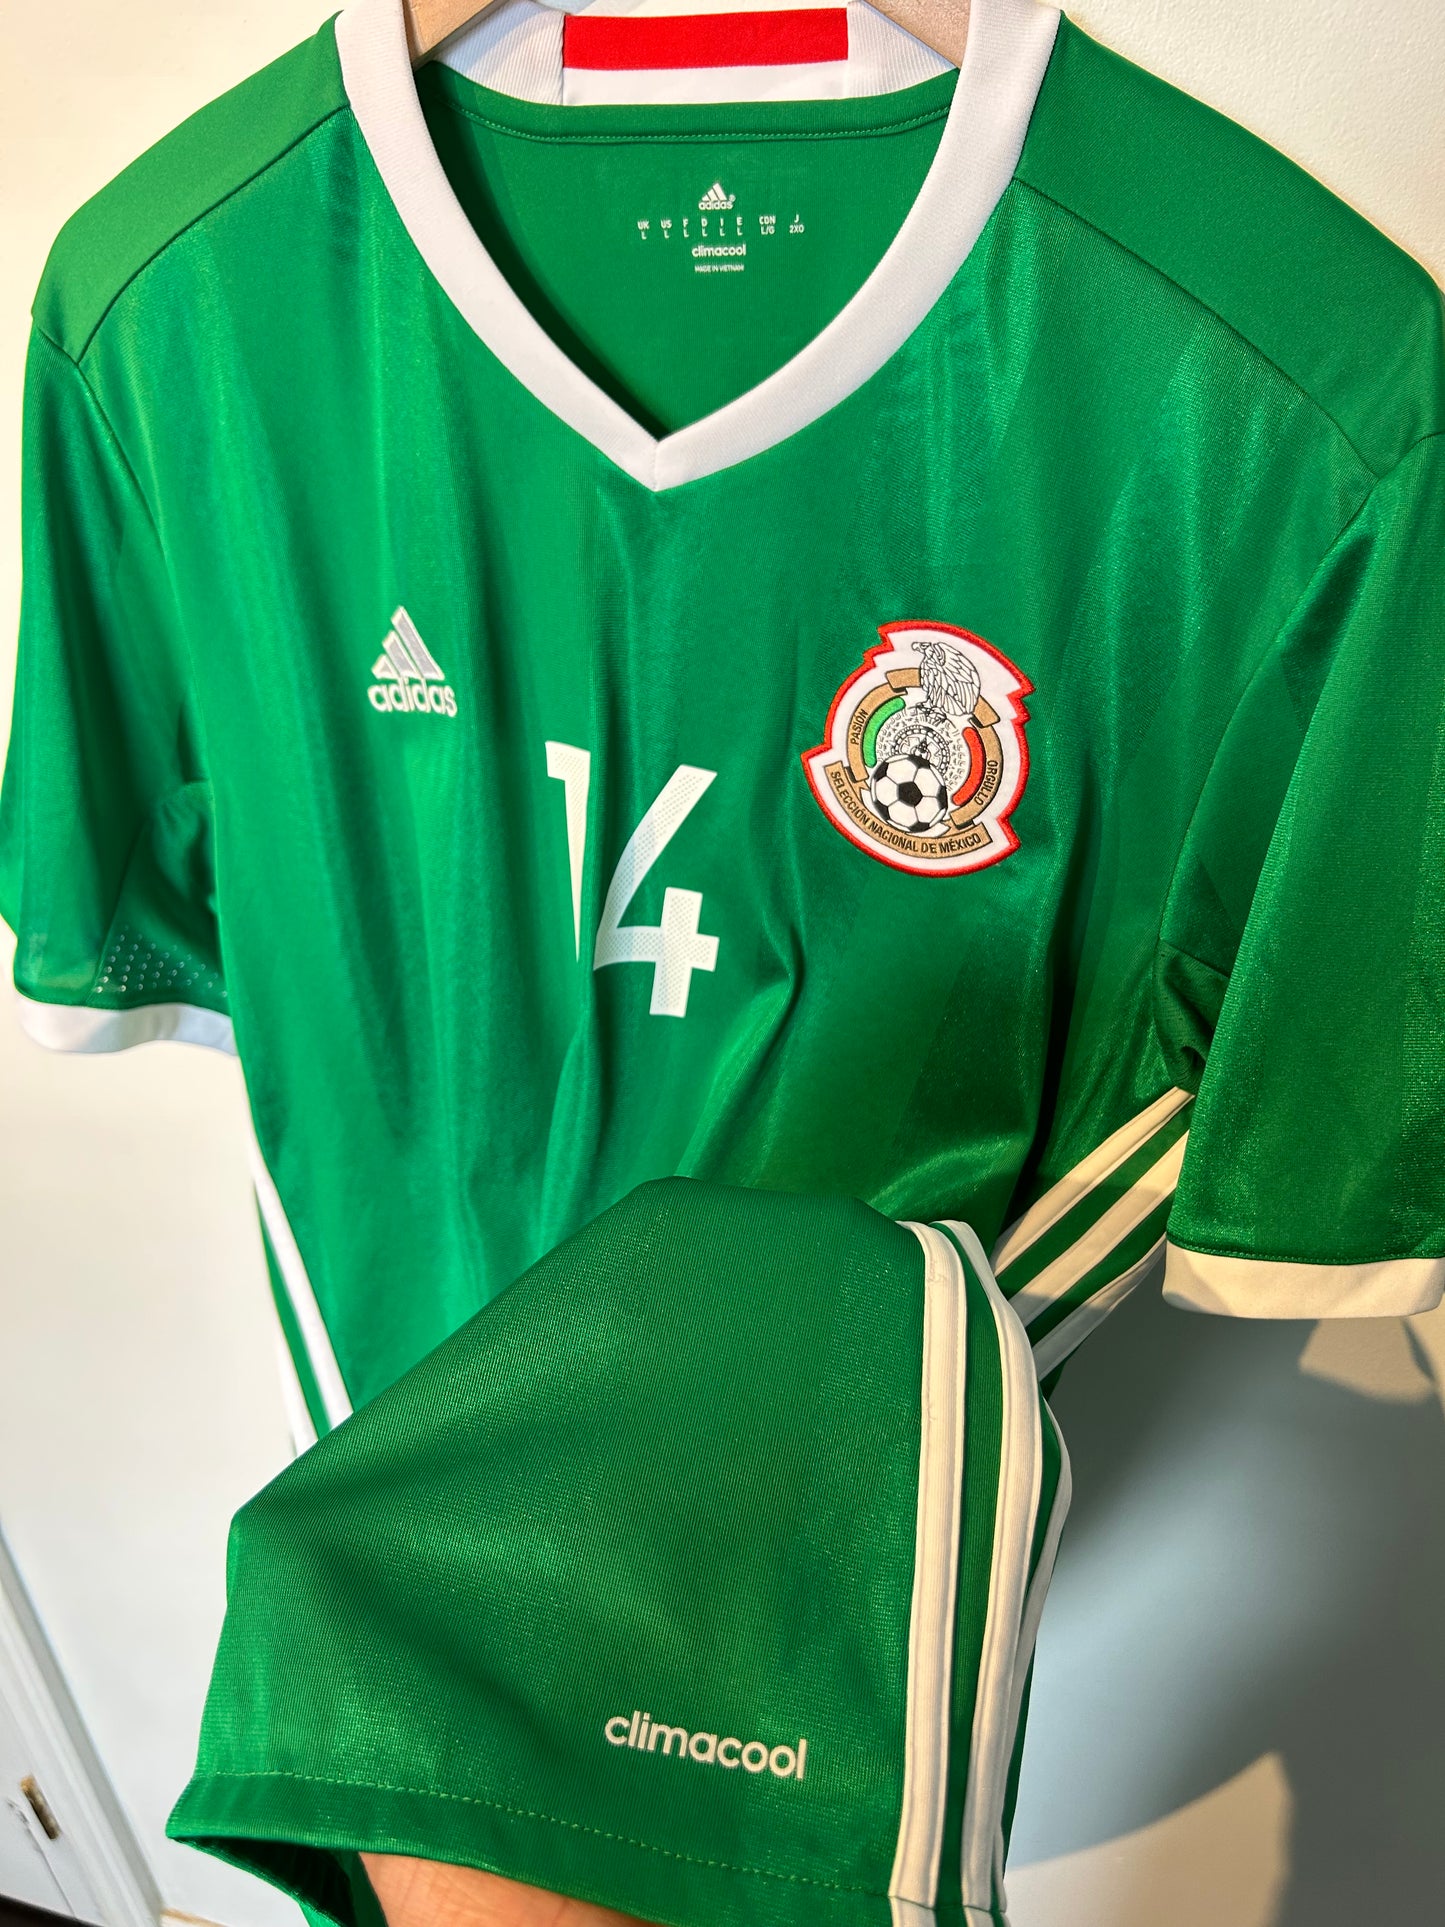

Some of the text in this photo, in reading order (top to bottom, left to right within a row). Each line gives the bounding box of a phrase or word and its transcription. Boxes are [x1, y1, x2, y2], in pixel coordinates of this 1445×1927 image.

[637, 220, 650, 230] UK
[660, 219, 672, 229] US
[682, 218, 689, 228] F
[701, 217, 708, 227] D
[736, 216, 743, 226] E
[758, 215, 776, 225] CDN
[794, 213, 800, 223] J
[698, 200, 734, 211] adidas
[641, 223, 804, 240] L L L L L L L/G 2XO
[691, 243, 747, 257] climacool
[694, 263, 745, 273] MADE IN VIETNAM
[367, 677, 458, 718] adidas
[850, 708, 869, 746] PASIÓN
[973, 759, 999, 807] ORGULLO
[830, 770, 982, 855] SELECCIÓN NACIONAL DE MÉXICO
[545, 741, 720, 1018] 14
[604, 1710, 808, 1780] climacool
